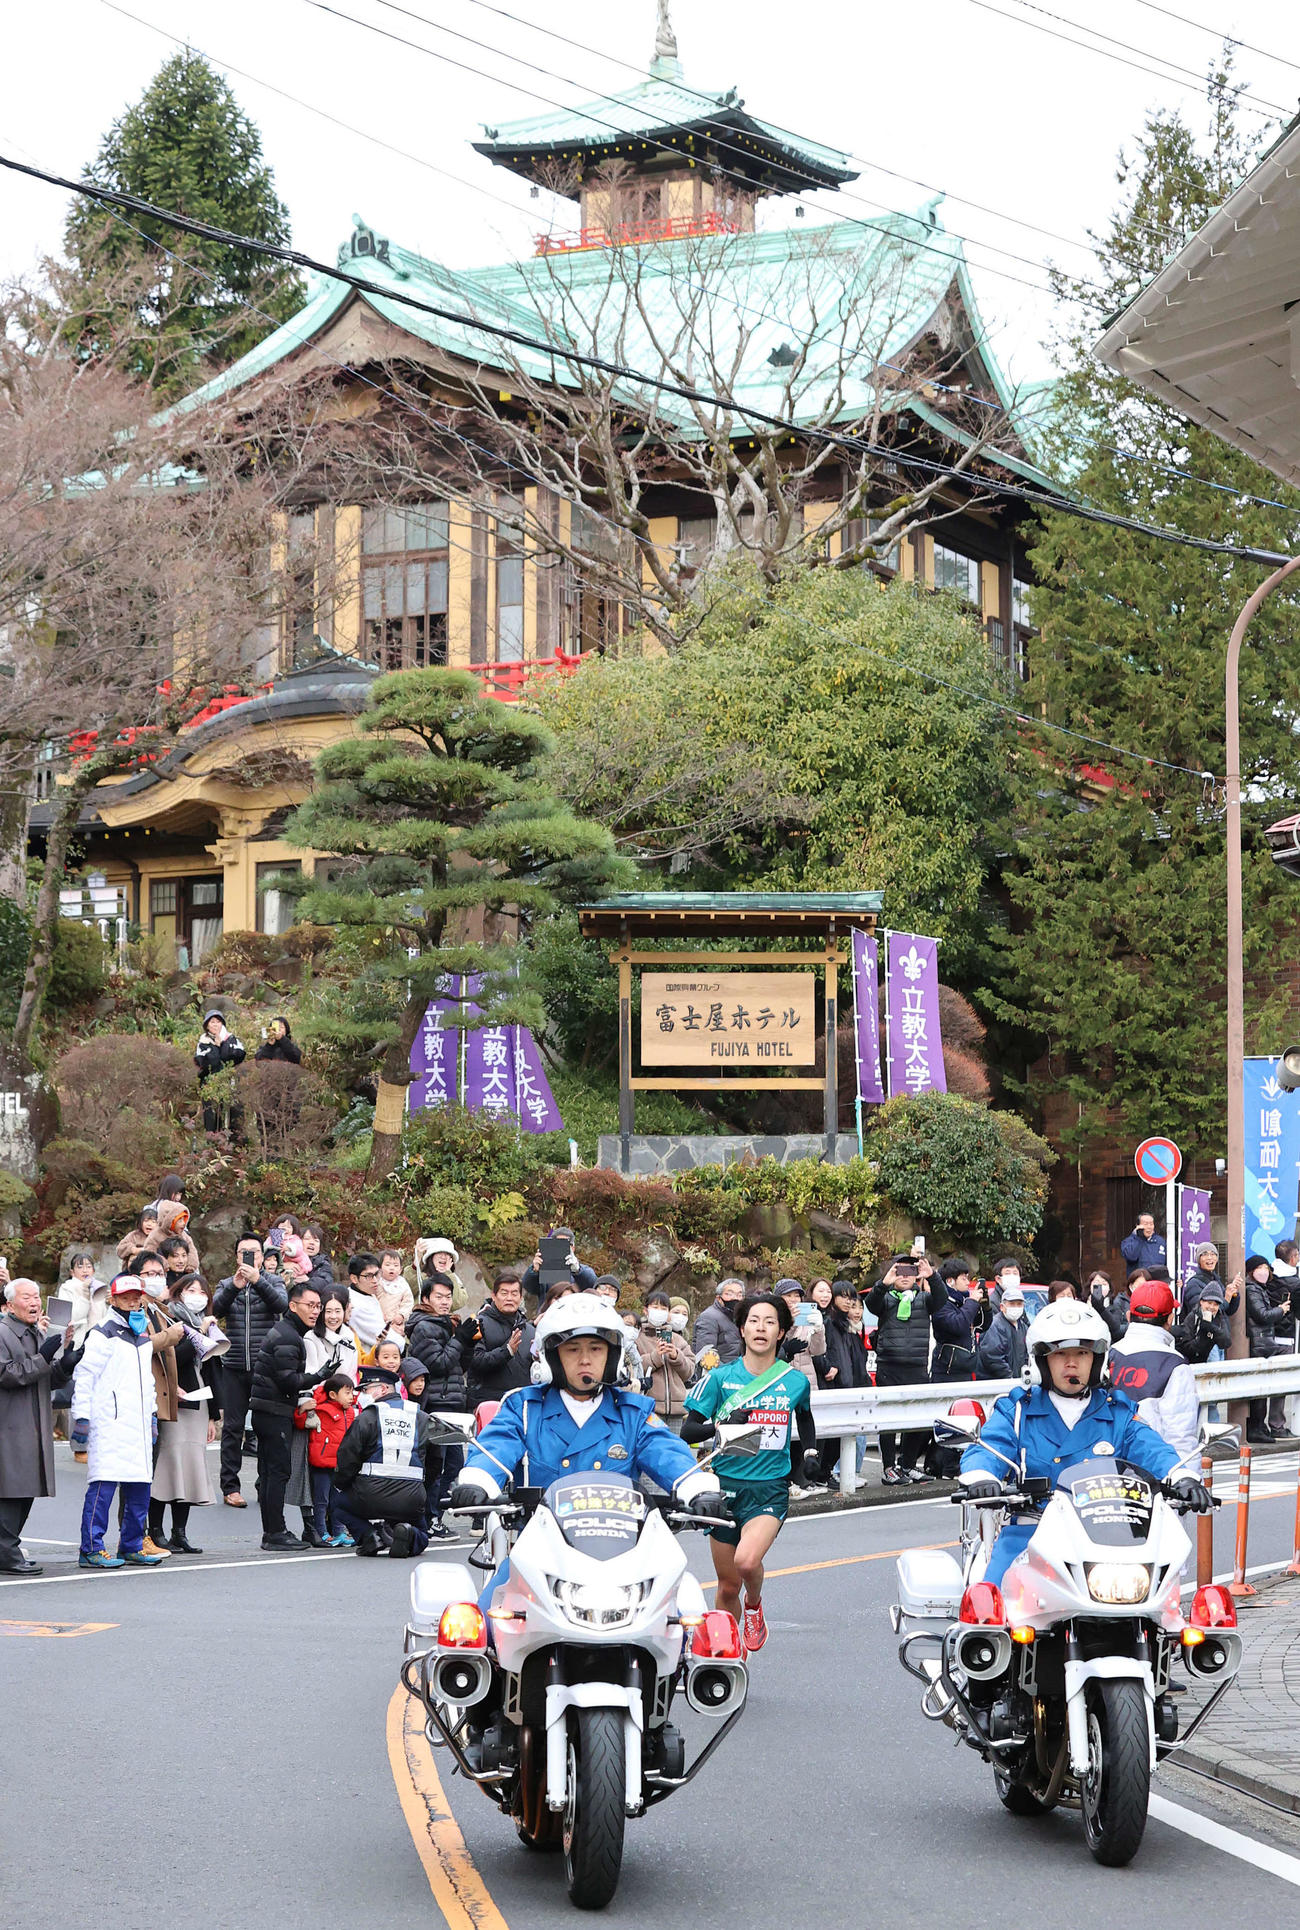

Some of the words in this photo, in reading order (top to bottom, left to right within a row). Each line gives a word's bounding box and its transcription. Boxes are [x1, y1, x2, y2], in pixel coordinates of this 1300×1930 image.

[655, 1002, 801, 1033] 富士屋ホテル
[901, 985, 932, 1092] 立教大学
[711, 1042, 750, 1056] FUJIYA
[757, 1042, 793, 1056] HOTEL
[423, 1005, 448, 1109] 立教大学
[482, 1020, 509, 1119] 立教大学
[740, 1395, 791, 1411] 山学院
[1081, 1505, 1149, 1518] POLICE
[563, 1518, 638, 1532] POLICE
[1093, 1516, 1142, 1524] HONDA
[575, 1529, 629, 1538] HONDA
